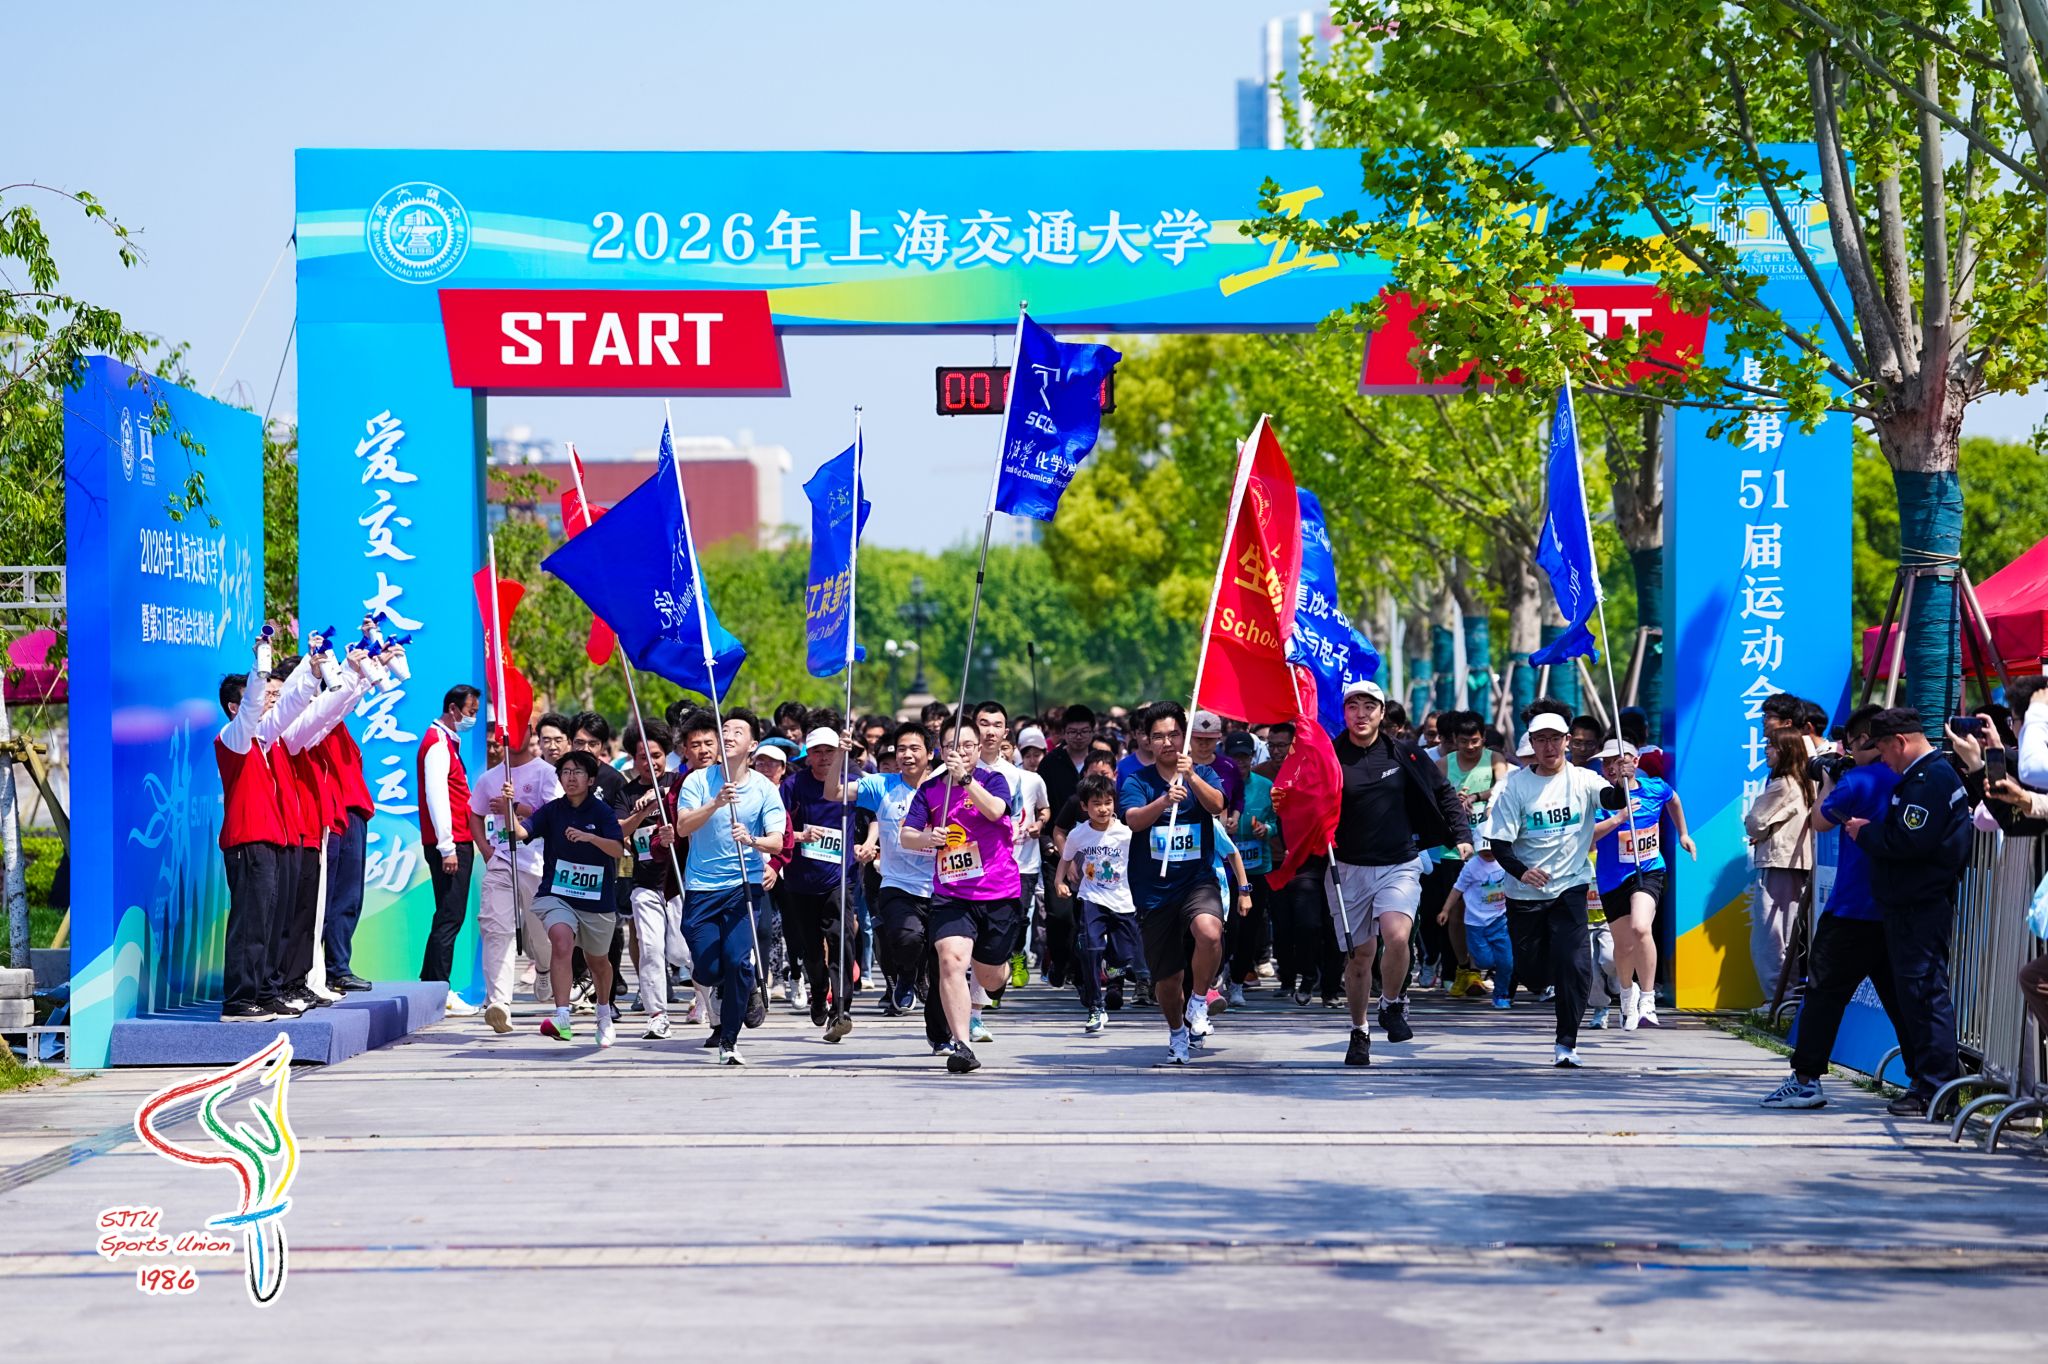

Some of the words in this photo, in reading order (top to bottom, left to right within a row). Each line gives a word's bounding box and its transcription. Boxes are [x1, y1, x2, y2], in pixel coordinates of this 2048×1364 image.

[590, 207, 1210, 267] 2026年上海交通大学
[500, 311, 724, 366] START
[140, 527, 219, 588] 2026年上海交通大学
[141, 602, 215, 647] 暨第51届运动会长跑比赛
[1533, 811, 1543, 826] A
[1547, 806, 1571, 824] 189
[820, 835, 841, 851] 106
[1638, 834, 1657, 851] 065
[941, 857, 948, 872] C
[949, 852, 973, 870] 136
[560, 869, 569, 884] A
[571, 871, 598, 888] 200
